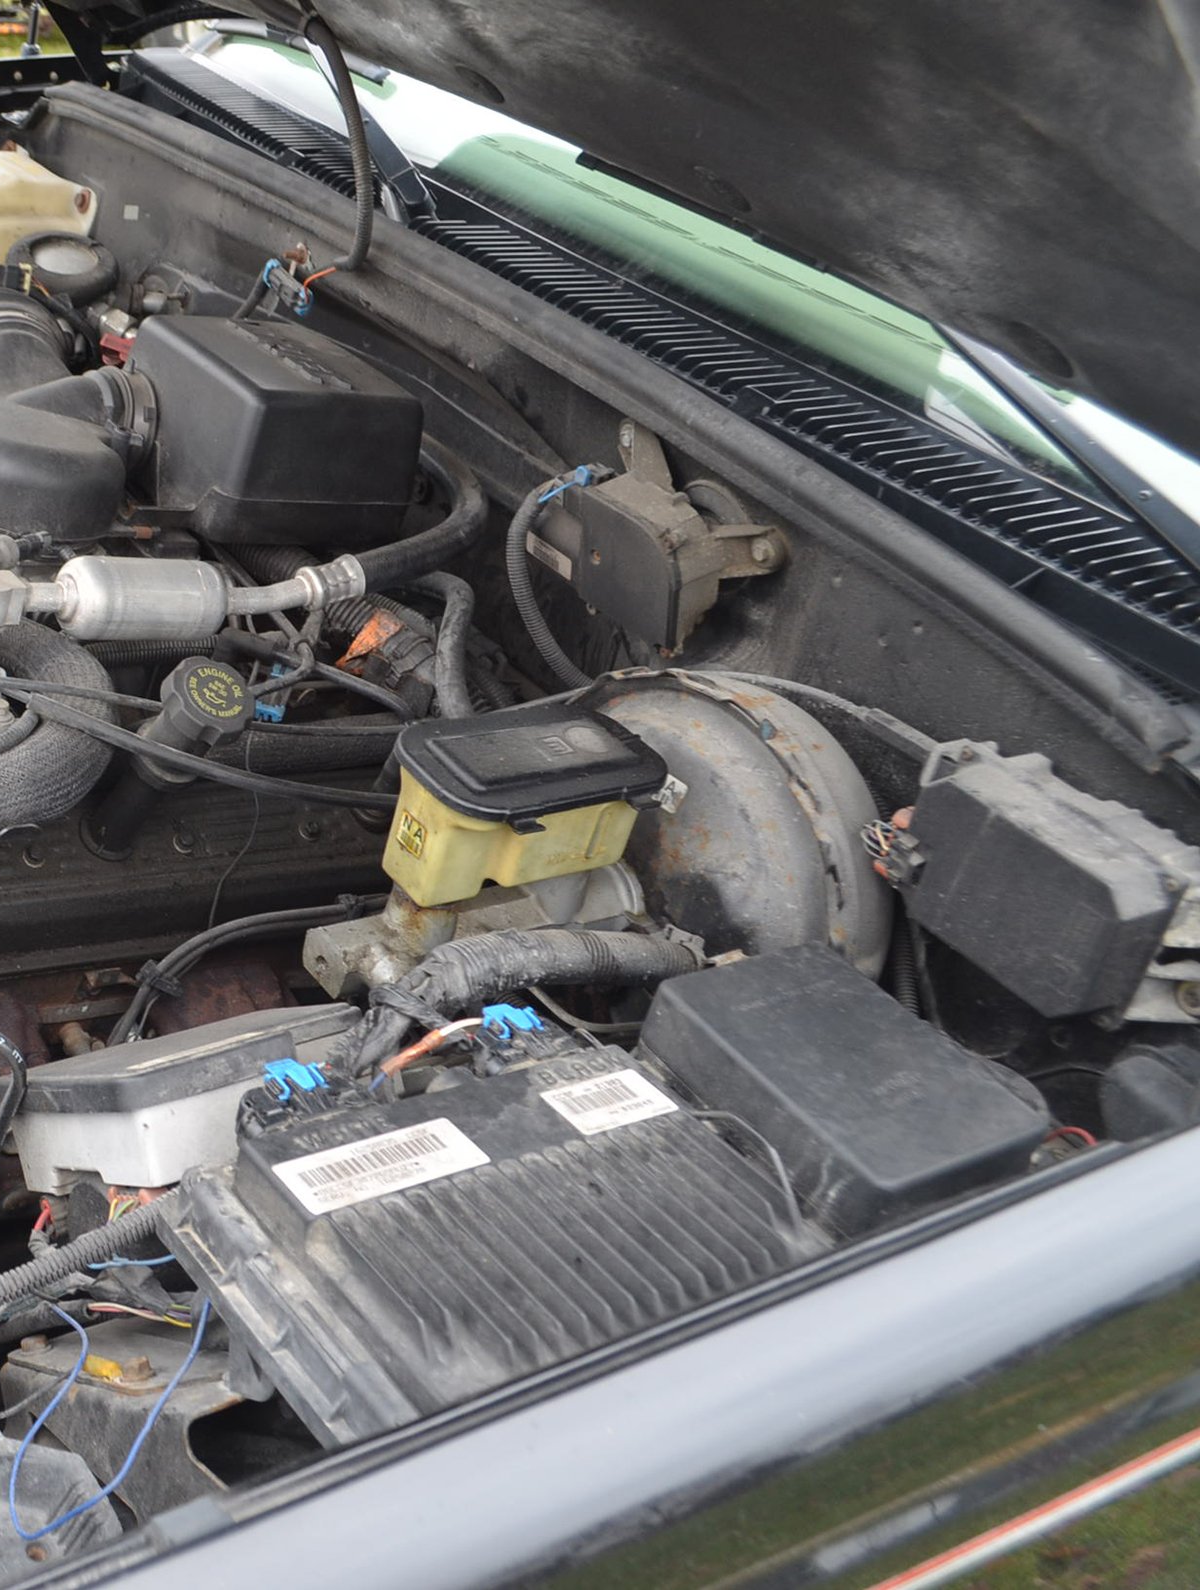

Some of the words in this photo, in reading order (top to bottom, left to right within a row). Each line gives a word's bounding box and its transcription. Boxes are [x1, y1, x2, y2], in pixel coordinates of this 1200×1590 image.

[197, 667, 234, 685] ENGINE
[232, 685, 244, 698] OIL
[538, 1054, 626, 1085] BLACK
